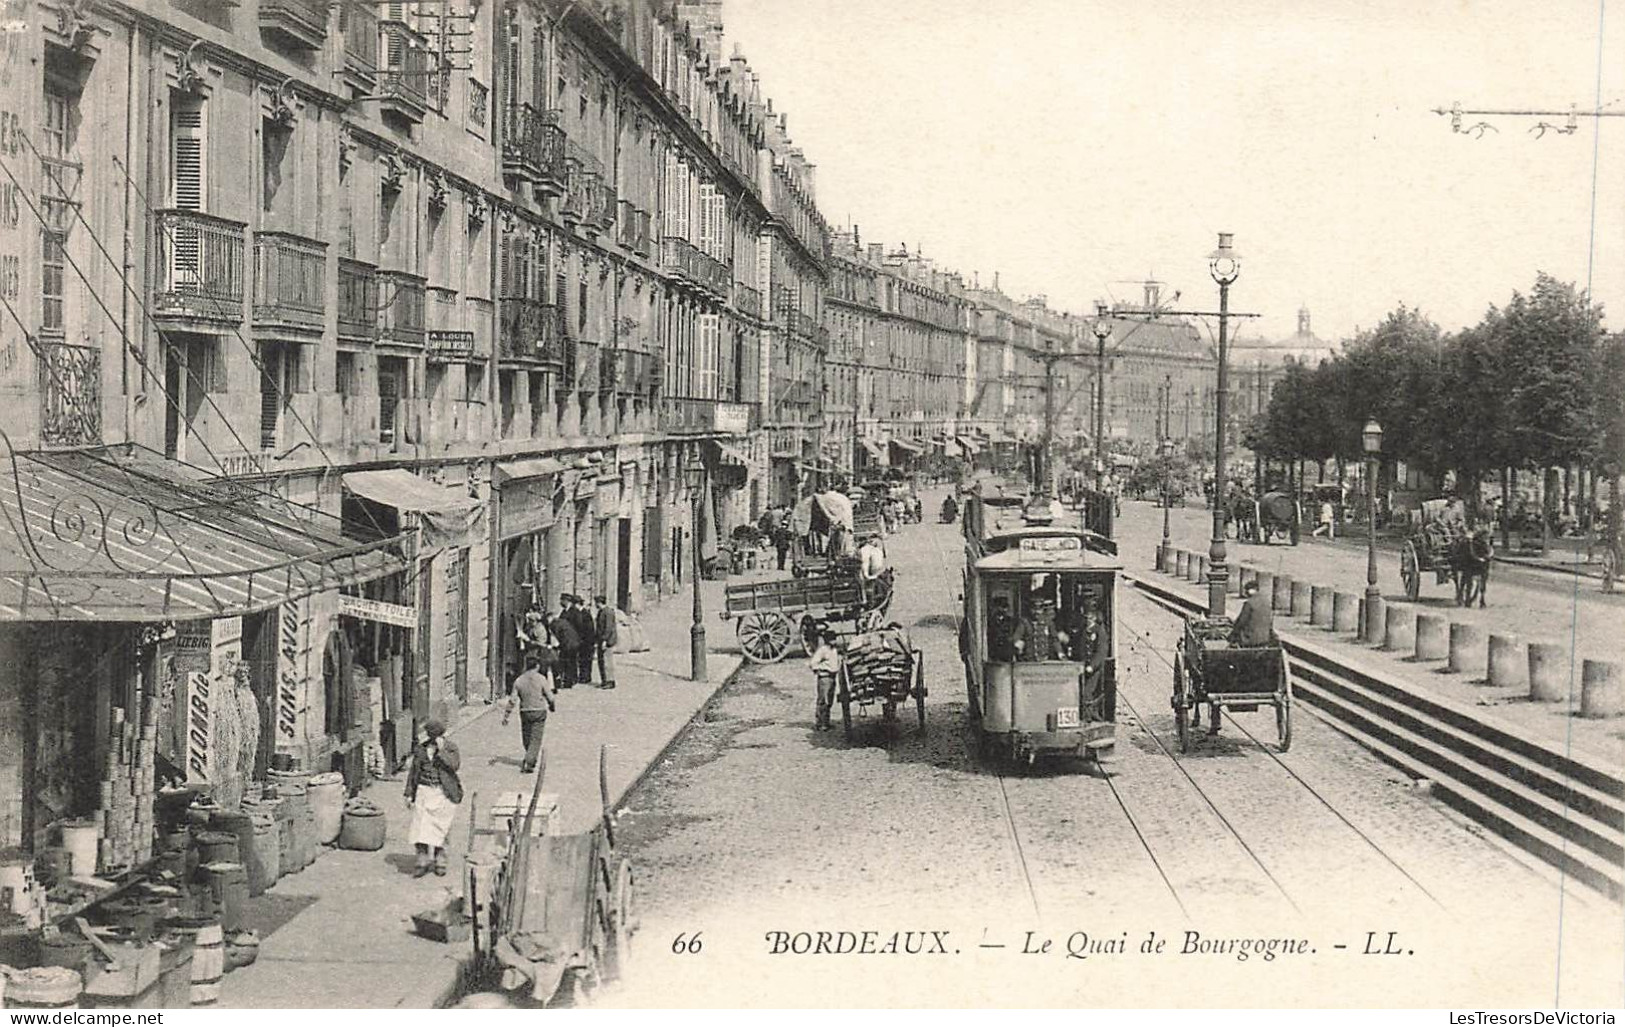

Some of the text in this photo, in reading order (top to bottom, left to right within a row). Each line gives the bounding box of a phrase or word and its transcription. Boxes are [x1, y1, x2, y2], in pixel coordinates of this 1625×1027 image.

[385, 604, 417, 618] TOILES
[1058, 710, 1078, 725] 130
[190, 694, 209, 780] PLOMB
